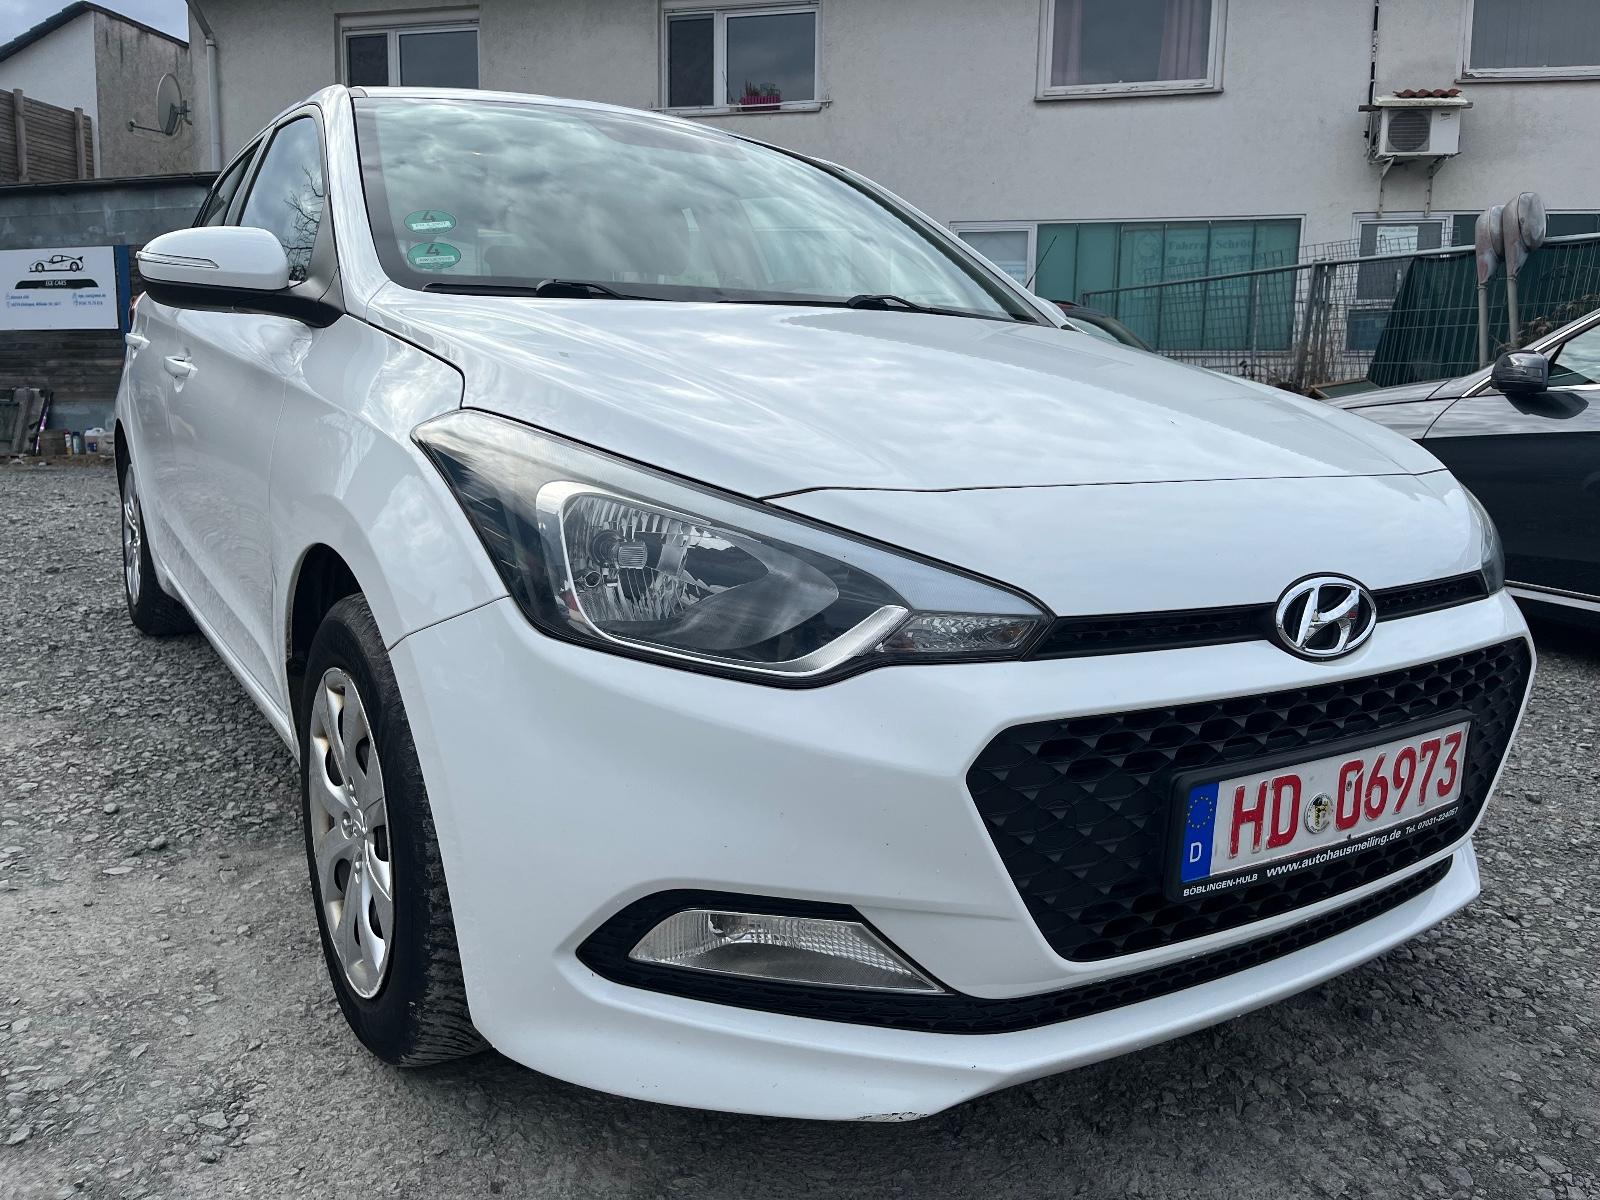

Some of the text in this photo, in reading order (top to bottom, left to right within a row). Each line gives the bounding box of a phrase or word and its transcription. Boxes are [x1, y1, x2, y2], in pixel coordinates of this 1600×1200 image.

[1168, 240, 1212, 250] Fahrra
[1228, 774, 1302, 860] HD
[1335, 730, 1462, 831] 06973
[1183, 873, 1258, 897] BÖBLINGEN-HULB
[1266, 829, 1402, 878] www.autohausmeiling.de
[1189, 841, 1202, 863] D
